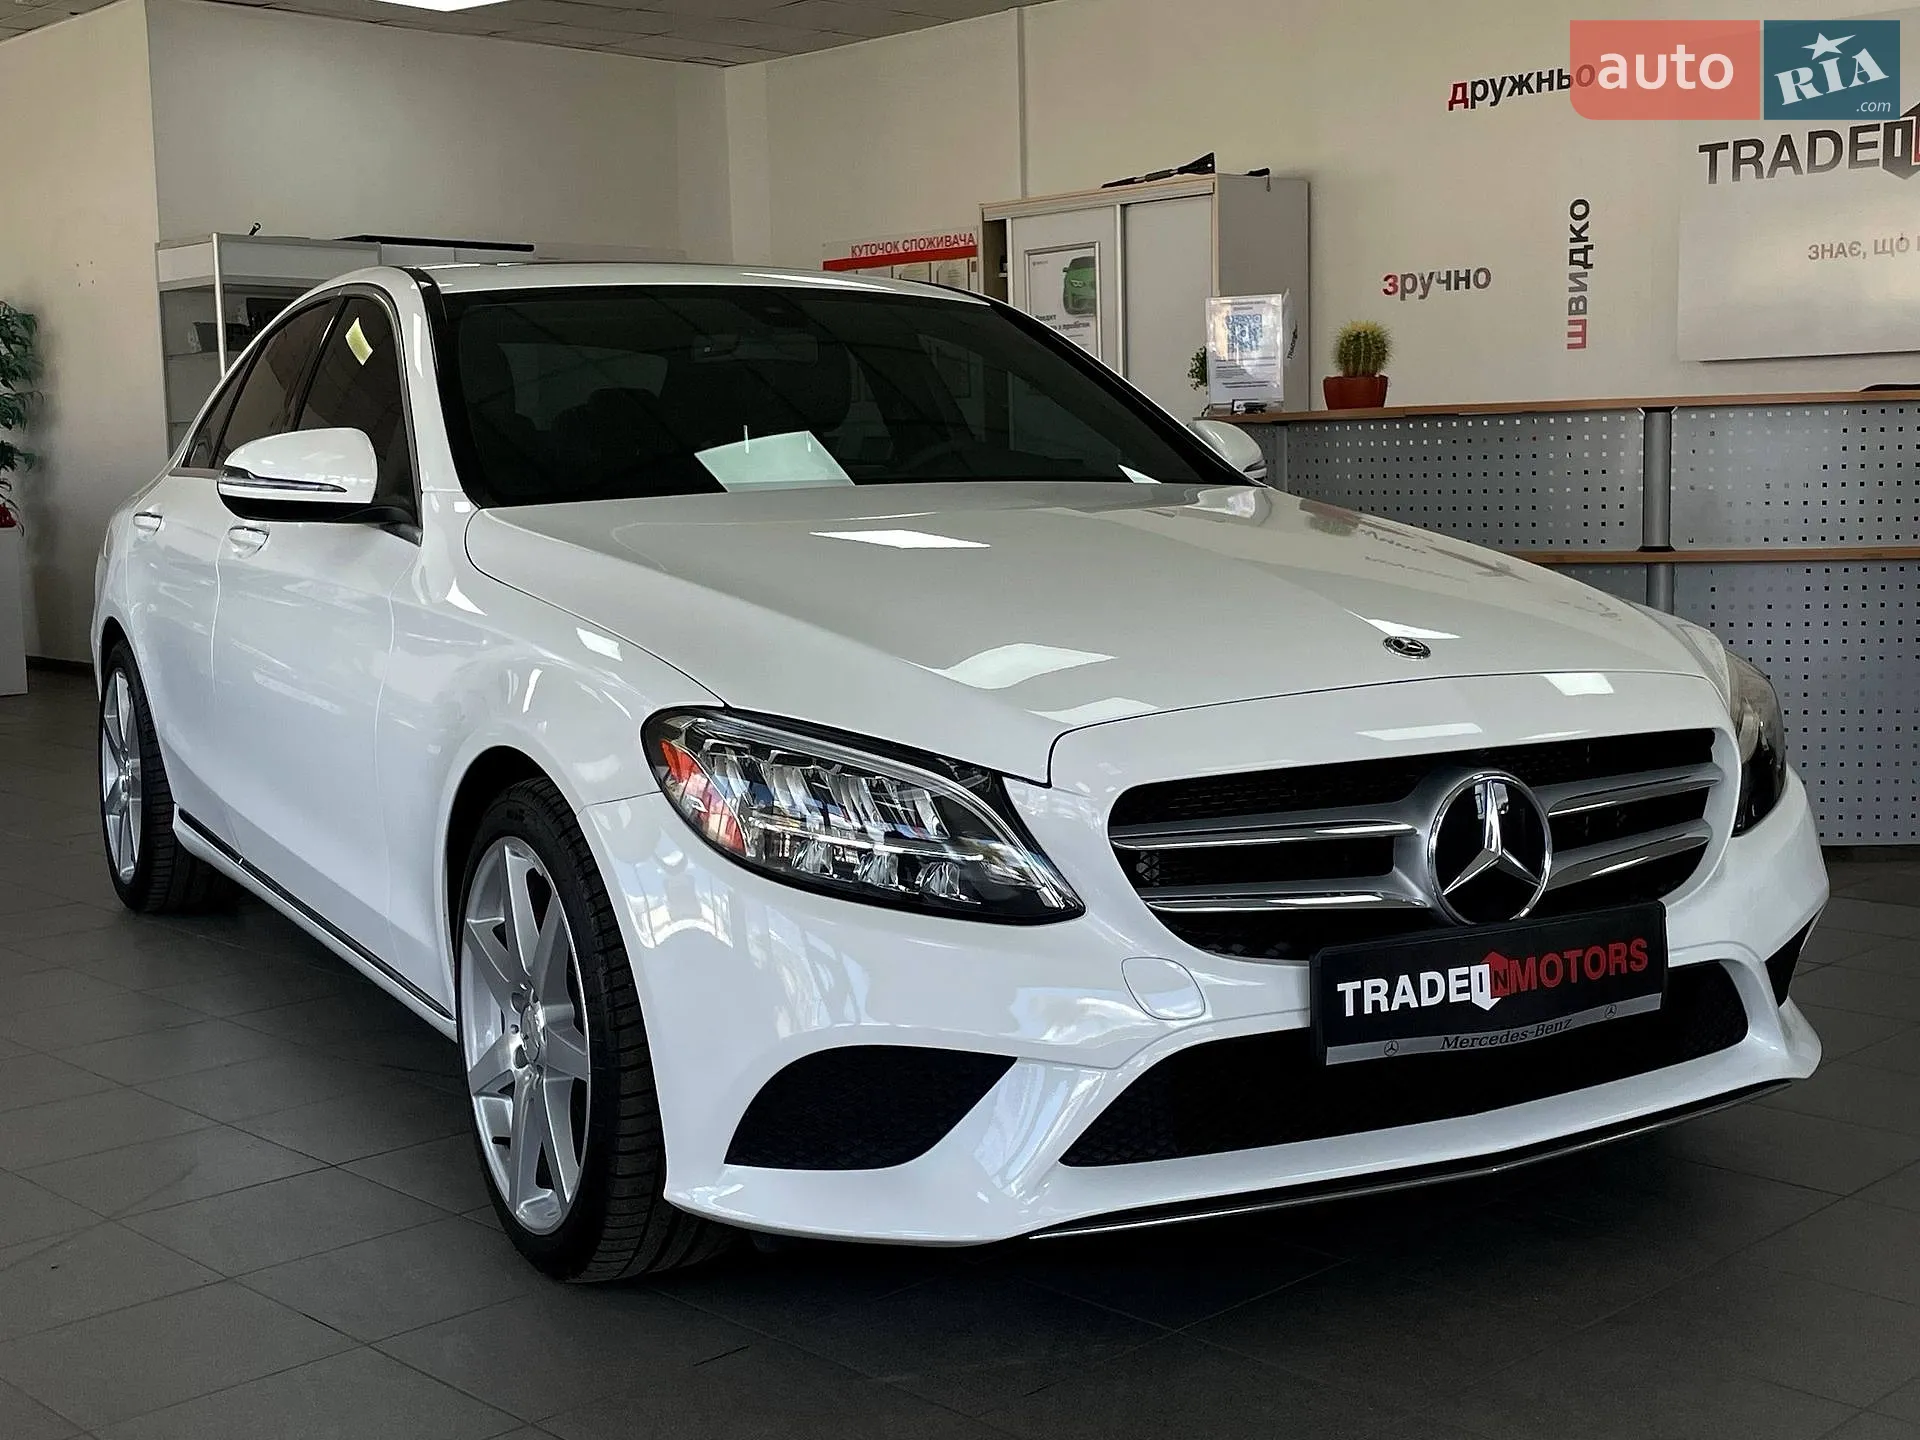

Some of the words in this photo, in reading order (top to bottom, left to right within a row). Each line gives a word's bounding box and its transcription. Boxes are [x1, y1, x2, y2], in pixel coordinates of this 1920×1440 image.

[851, 241, 901, 258] КУТОЧОК
[902, 232, 976, 252] СПОЖИВАЧА
[1381, 266, 1493, 301] зручно
[1440, 1016, 1574, 1051] Mercedes-Benz
